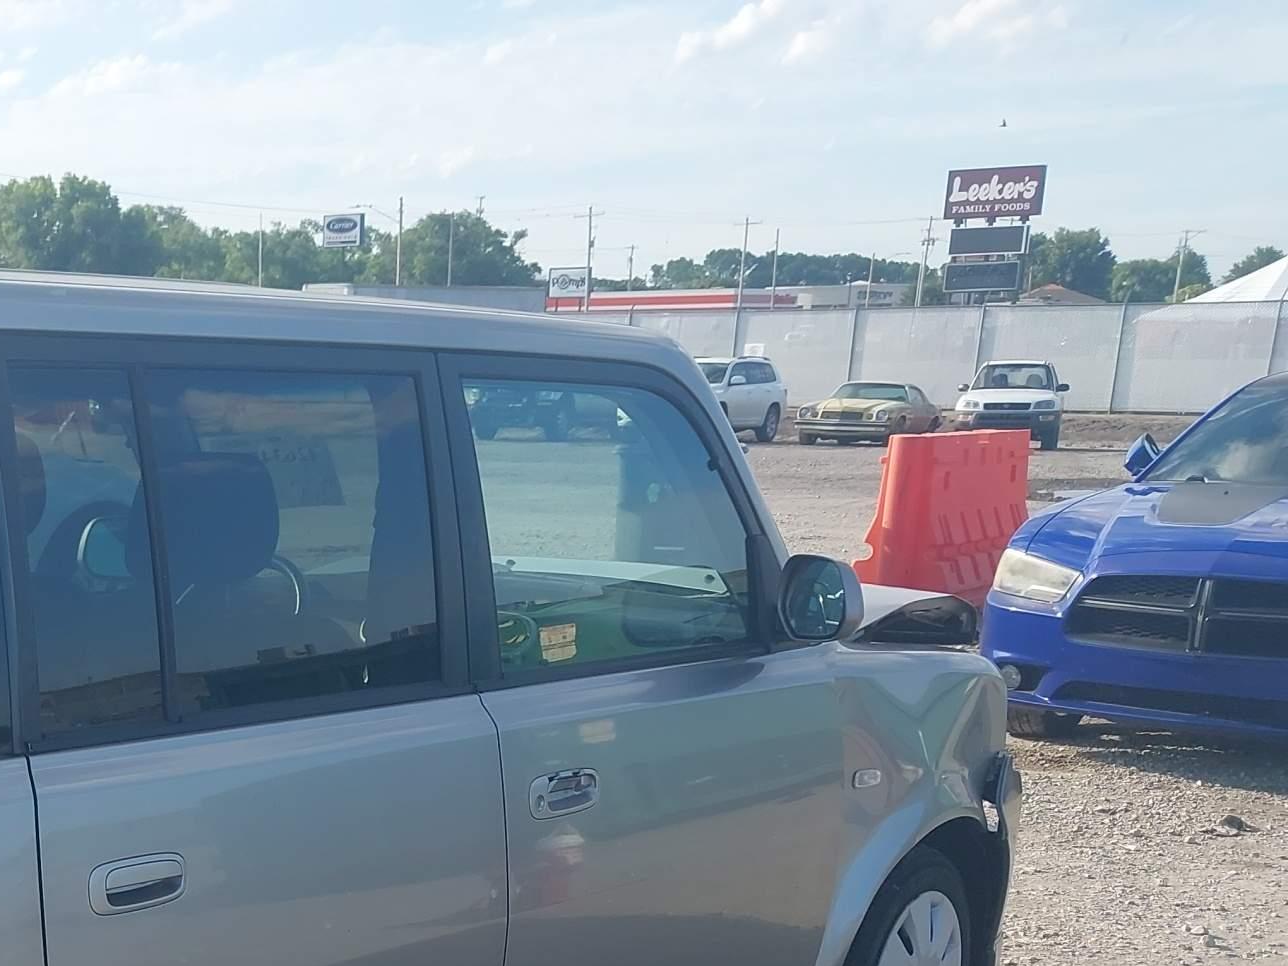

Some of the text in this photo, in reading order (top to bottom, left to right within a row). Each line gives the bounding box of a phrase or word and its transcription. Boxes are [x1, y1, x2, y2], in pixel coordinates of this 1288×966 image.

[948, 174, 1039, 203] Leeker's
[951, 202, 1031, 214] FAMILY FOODS
